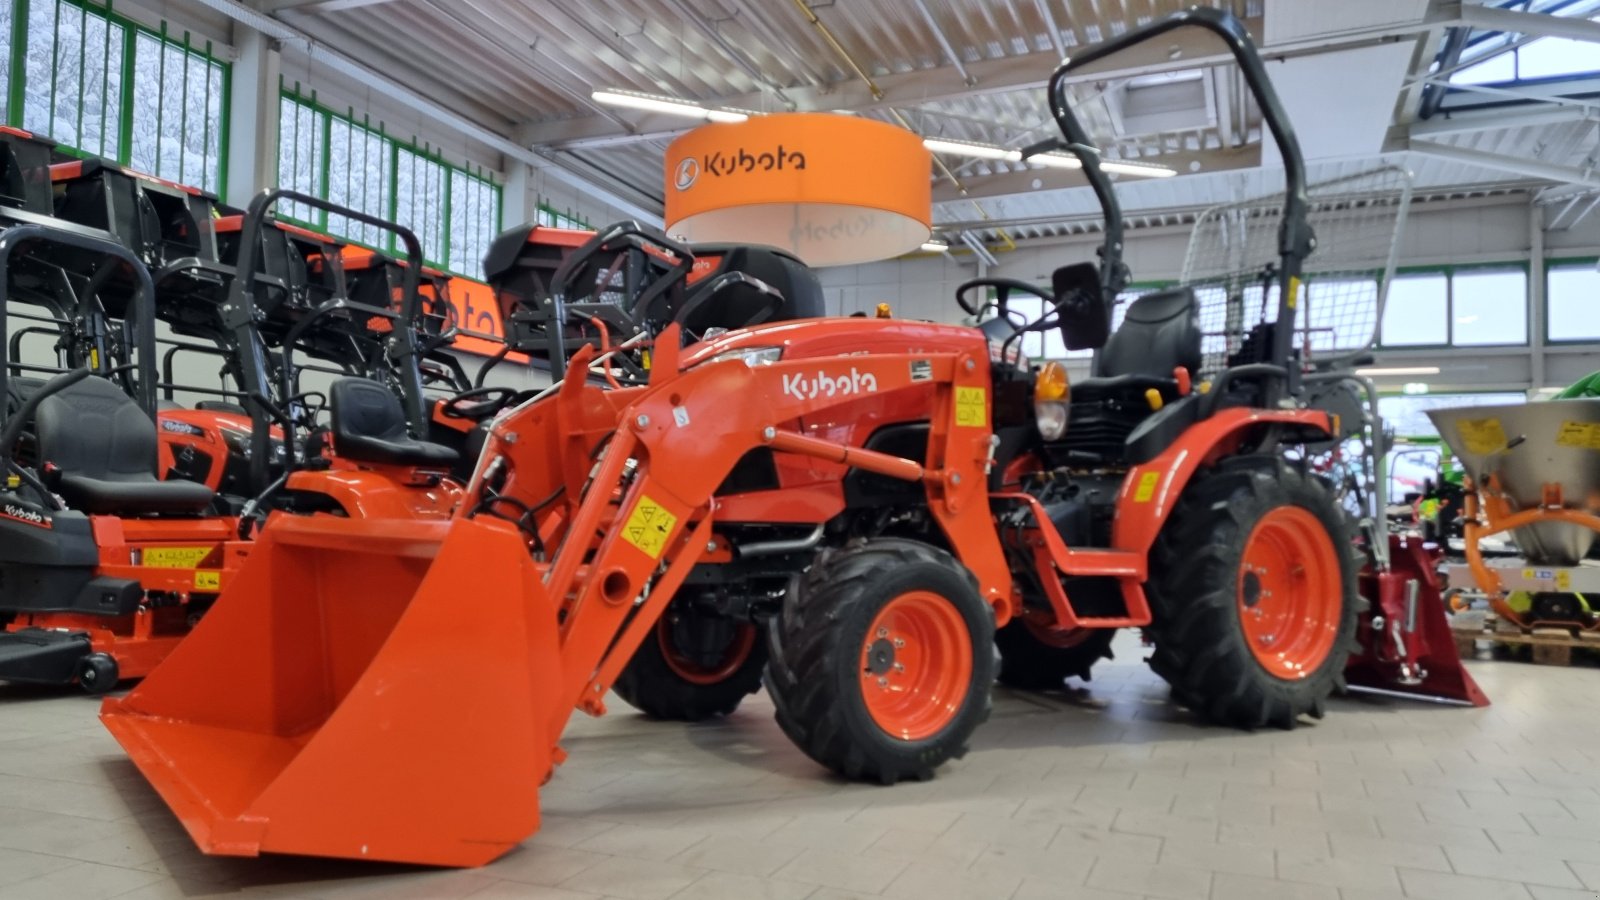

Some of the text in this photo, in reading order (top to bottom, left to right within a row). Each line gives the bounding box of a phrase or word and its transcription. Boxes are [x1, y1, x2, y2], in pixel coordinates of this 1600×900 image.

[704, 145, 806, 177] Kubota
[783, 367, 878, 400] Kubota
[4, 504, 43, 523] Kubota
